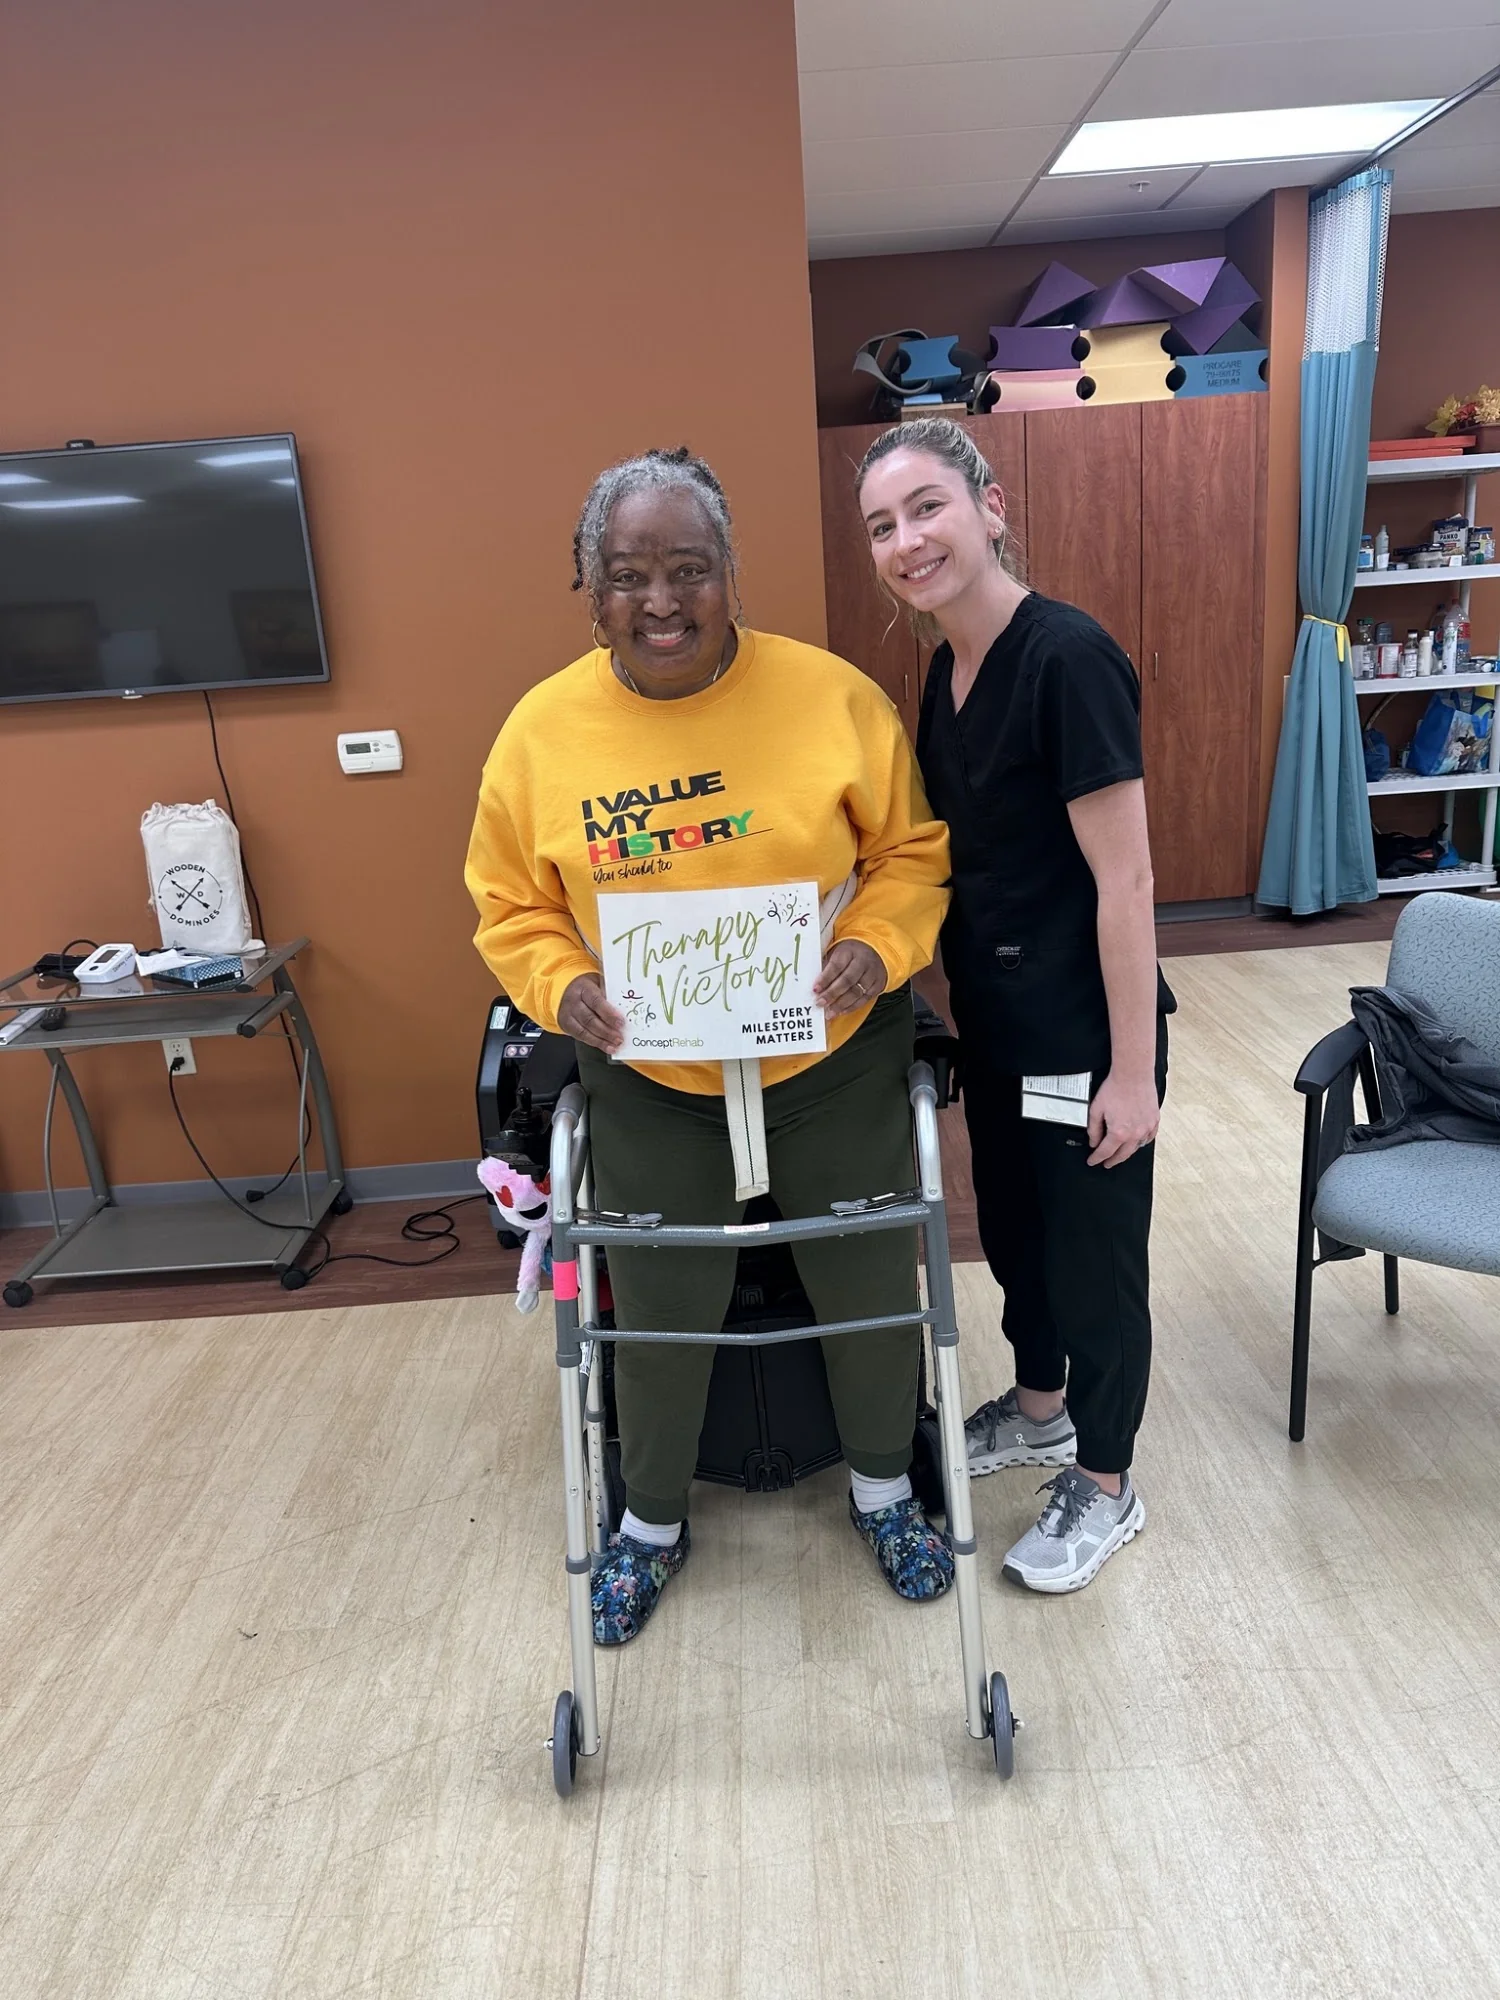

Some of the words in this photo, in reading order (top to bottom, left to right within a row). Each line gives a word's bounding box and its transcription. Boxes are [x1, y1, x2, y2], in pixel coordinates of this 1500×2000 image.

[1202, 359, 1242, 371] PROCARE
[1207, 378, 1241, 388] MEDIUM
[1439, 533, 1459, 541] PANKO
[581, 799, 593, 820] I
[596, 770, 726, 816] VALUE
[585, 808, 654, 842] MY
[588, 809, 755, 865] HISTORY
[166, 863, 206, 876] WOODEN
[593, 866, 615, 884] You
[617, 860, 656, 880] should
[657, 858, 673, 874] too
[169, 909, 221, 927] DOMINOES
[612, 910, 764, 982] Therapy
[657, 933, 801, 1025] Victory!
[772, 1006, 813, 1020] EVERY
[741, 1019, 813, 1035] MILESTONE
[632, 1037, 704, 1050] ConceptRehab
[755, 1030, 814, 1046] MATTERS
